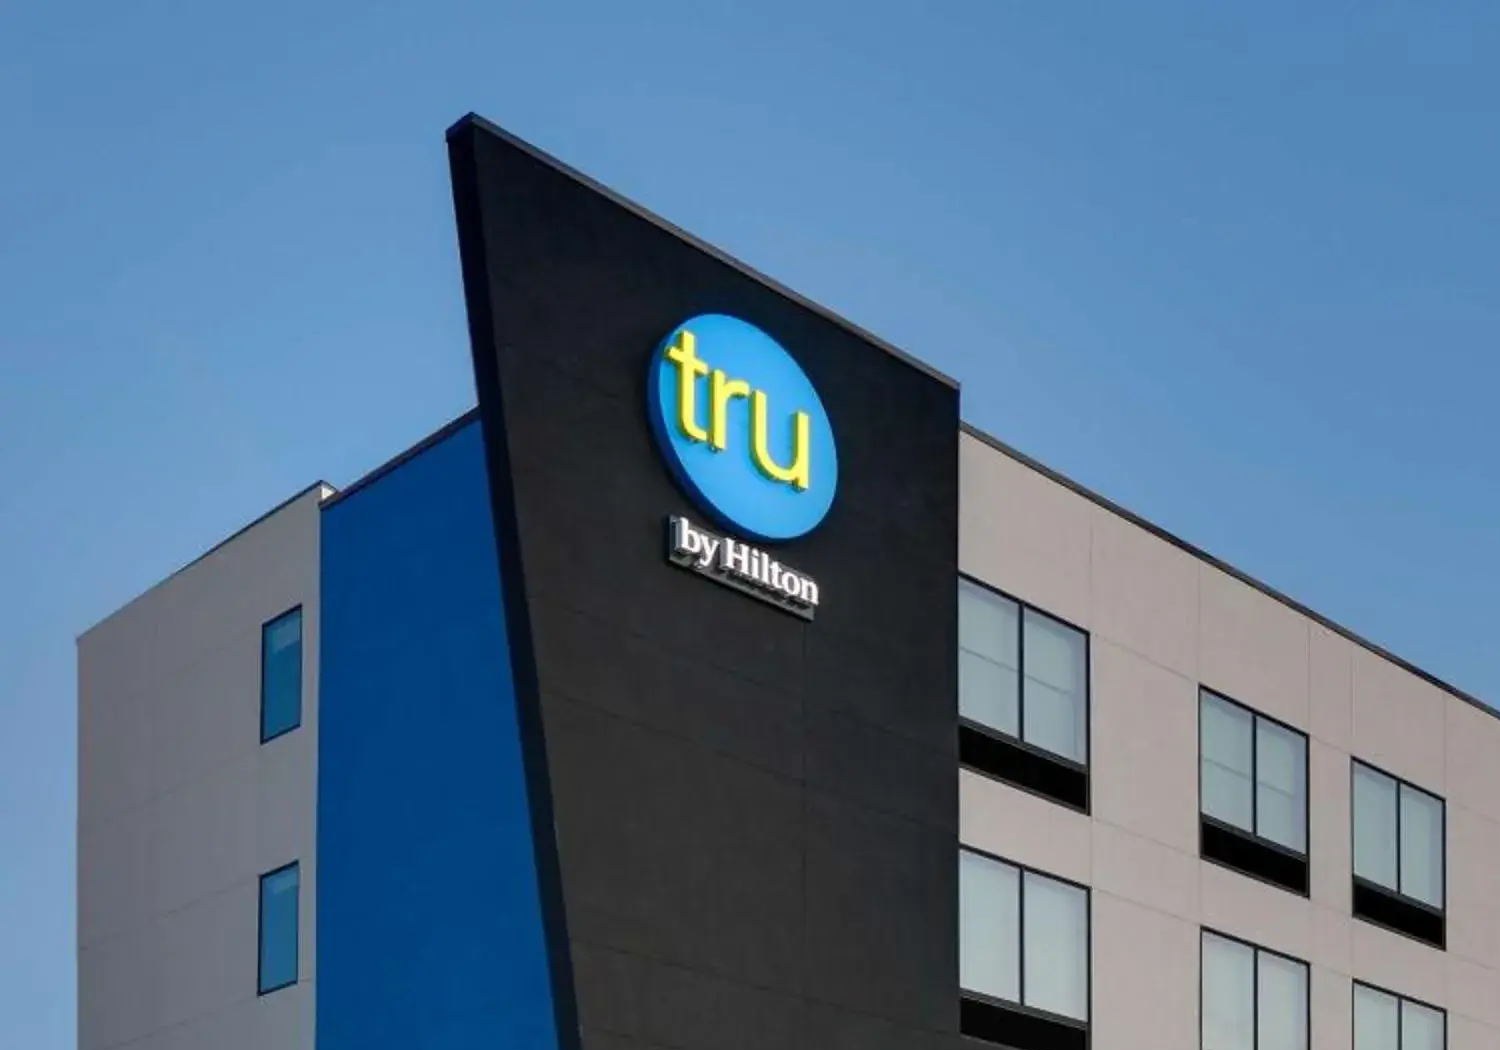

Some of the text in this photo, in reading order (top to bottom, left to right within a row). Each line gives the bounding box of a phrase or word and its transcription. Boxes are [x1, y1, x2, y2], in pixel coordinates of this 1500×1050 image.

[664, 330, 809, 491] tru
[678, 517, 819, 605] by Hilton
